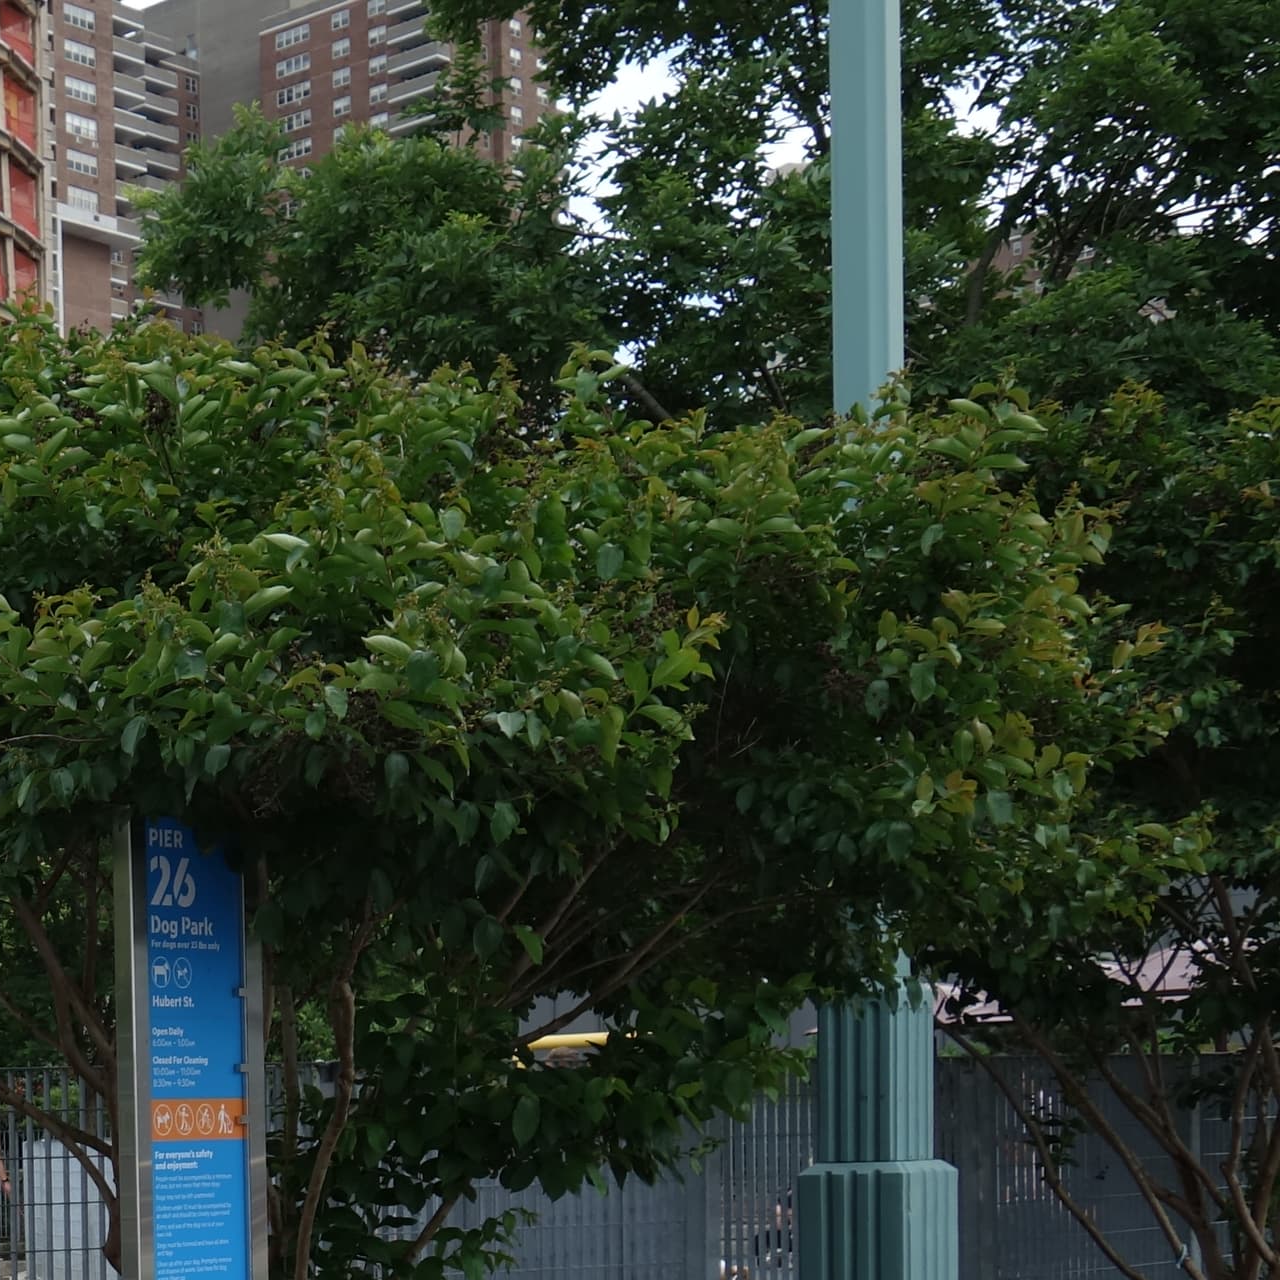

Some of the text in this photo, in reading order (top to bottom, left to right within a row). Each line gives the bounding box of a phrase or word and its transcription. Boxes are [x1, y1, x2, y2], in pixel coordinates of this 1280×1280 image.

[149, 828, 183, 848] PIER
[151, 856, 196, 907] 26
[151, 915, 213, 938] Dog Park
[153, 995, 194, 1007] Hubert St.
[152, 1027, 184, 1036] Open Daily
[153, 1056, 172, 1064] Closed
[184, 1056, 208, 1066] Cleaning
